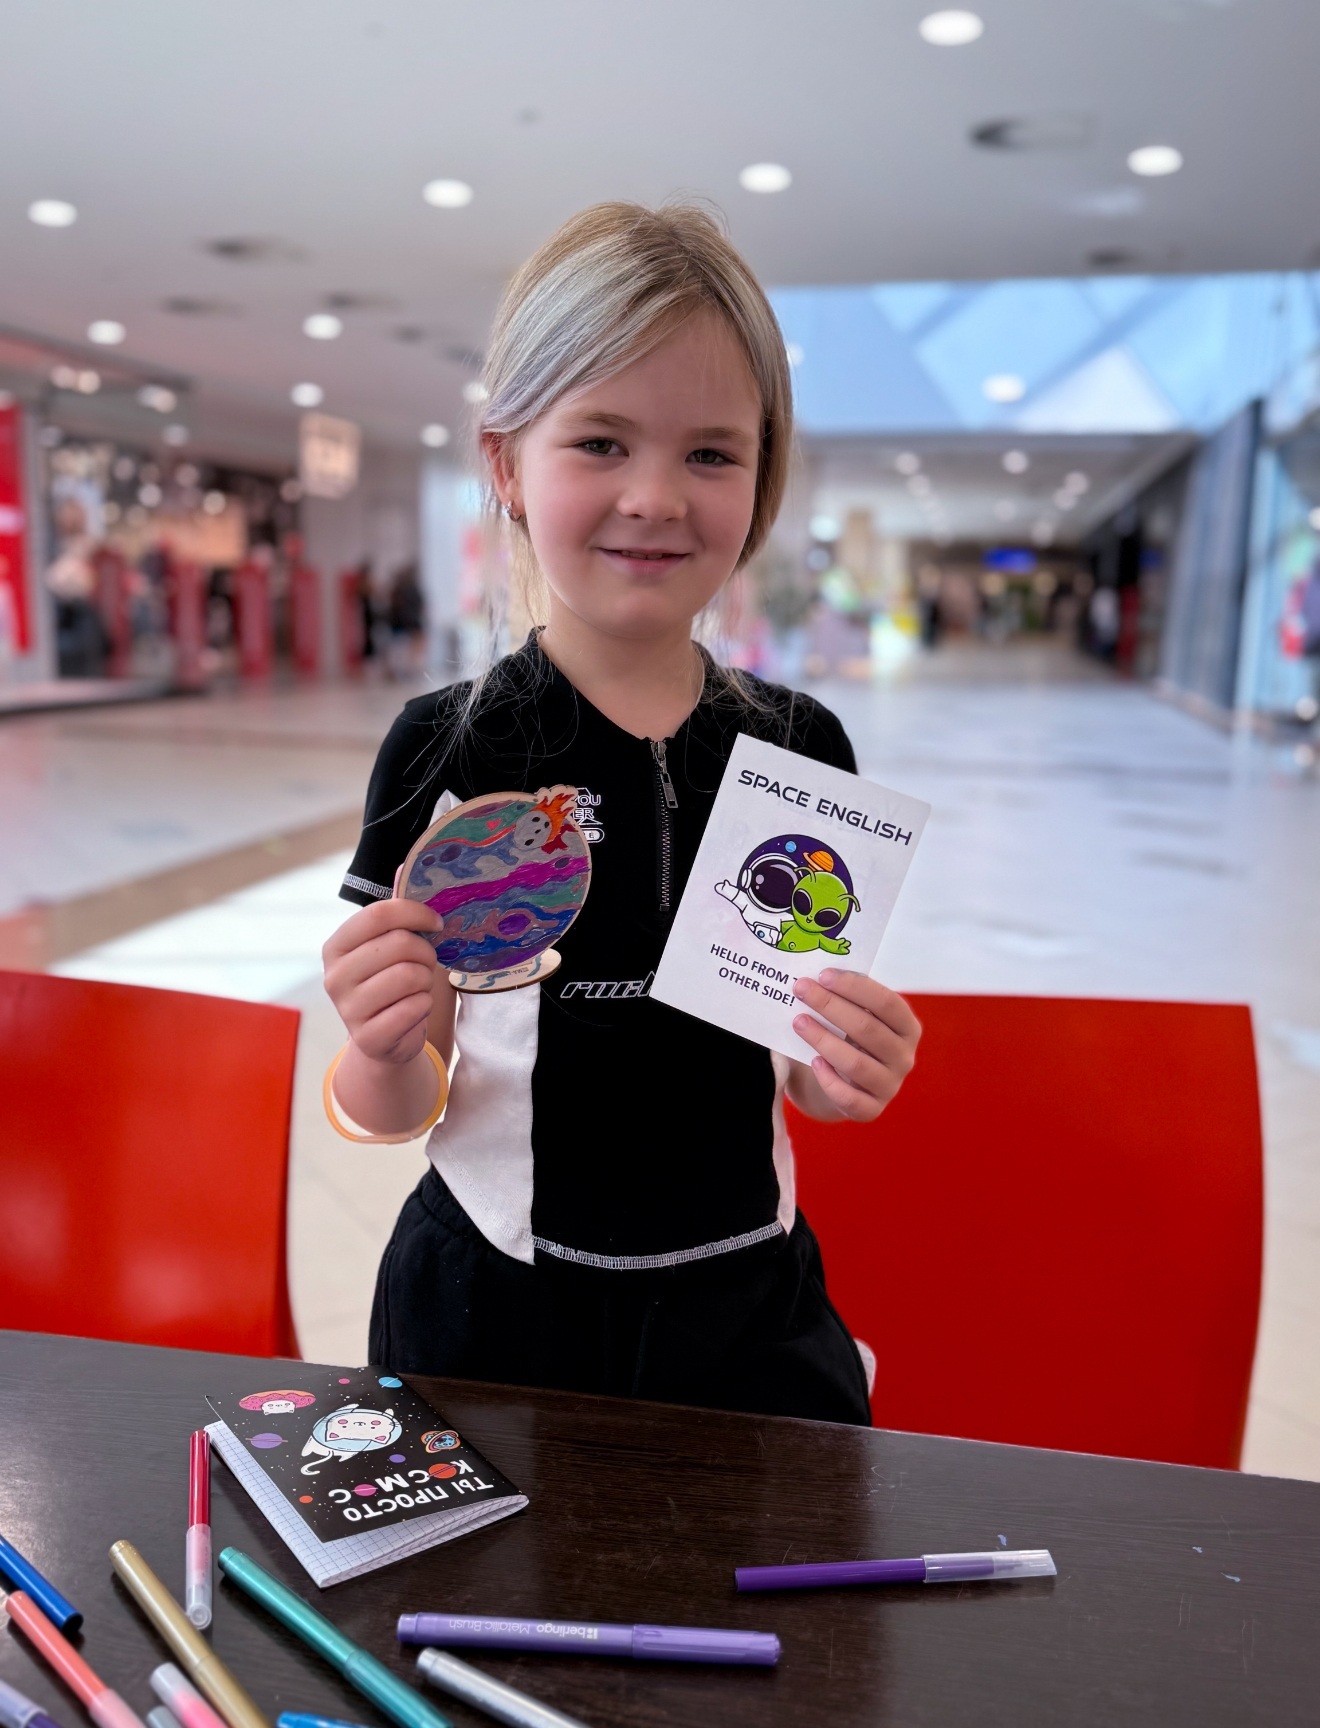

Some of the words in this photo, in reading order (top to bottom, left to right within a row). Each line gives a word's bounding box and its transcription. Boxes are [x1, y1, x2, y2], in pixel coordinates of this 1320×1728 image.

[575, 794, 602, 806] OU
[738, 769, 811, 808] SPACE
[816, 799, 913, 846] ENGLISH
[710, 943, 749, 968] HELLO
[751, 960, 790, 985] FROM
[718, 966, 760, 993] OTHER
[761, 985, 796, 1008] SIDE!
[452, 1476, 495, 1496] ТЫ
[342, 1484, 450, 1522] ПРОСТО
[449, 1618, 482, 1631] Brush
[485, 1620, 530, 1634] Metallic
[535, 1623, 586, 1639] berlingo
